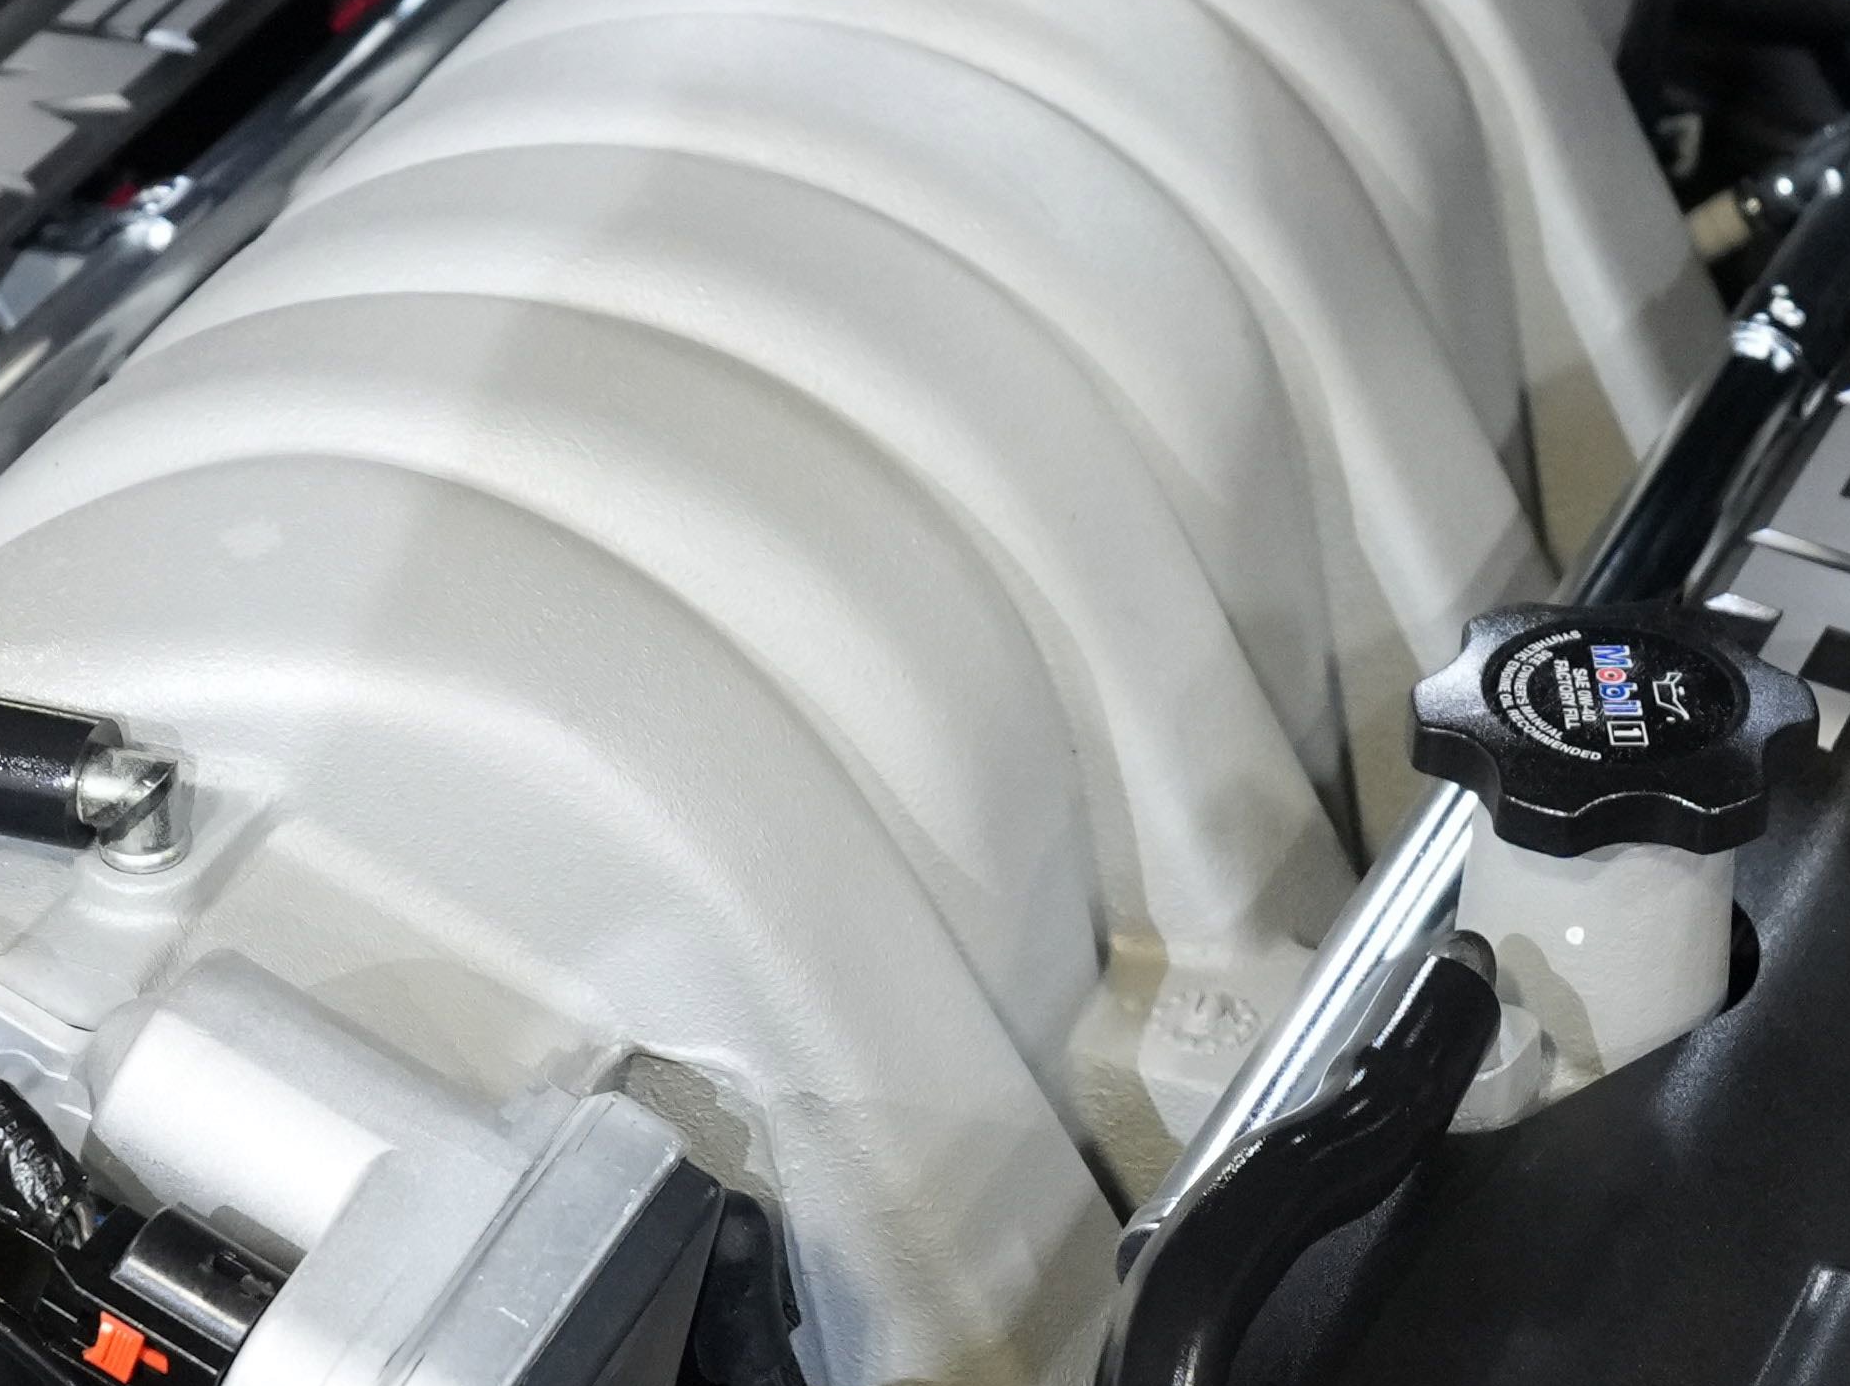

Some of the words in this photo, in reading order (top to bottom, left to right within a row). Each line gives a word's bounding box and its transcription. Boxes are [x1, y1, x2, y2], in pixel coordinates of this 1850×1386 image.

[1514, 630, 1581, 659] SYNTHETIC
[1529, 650, 1553, 665] SEE
[1498, 661, 1519, 692] ENGINE
[1554, 660, 1576, 707] FACTORY
[1573, 669, 1590, 687] SAE
[1590, 646, 1643, 715] Mobil
[1500, 694, 1512, 709] OIL
[1578, 690, 1597, 722] 0W-40
[1520, 705, 1563, 741] MANUAL
[1563, 708, 1579, 729] FILL
[1507, 710, 1601, 760] RECOMMENDED
